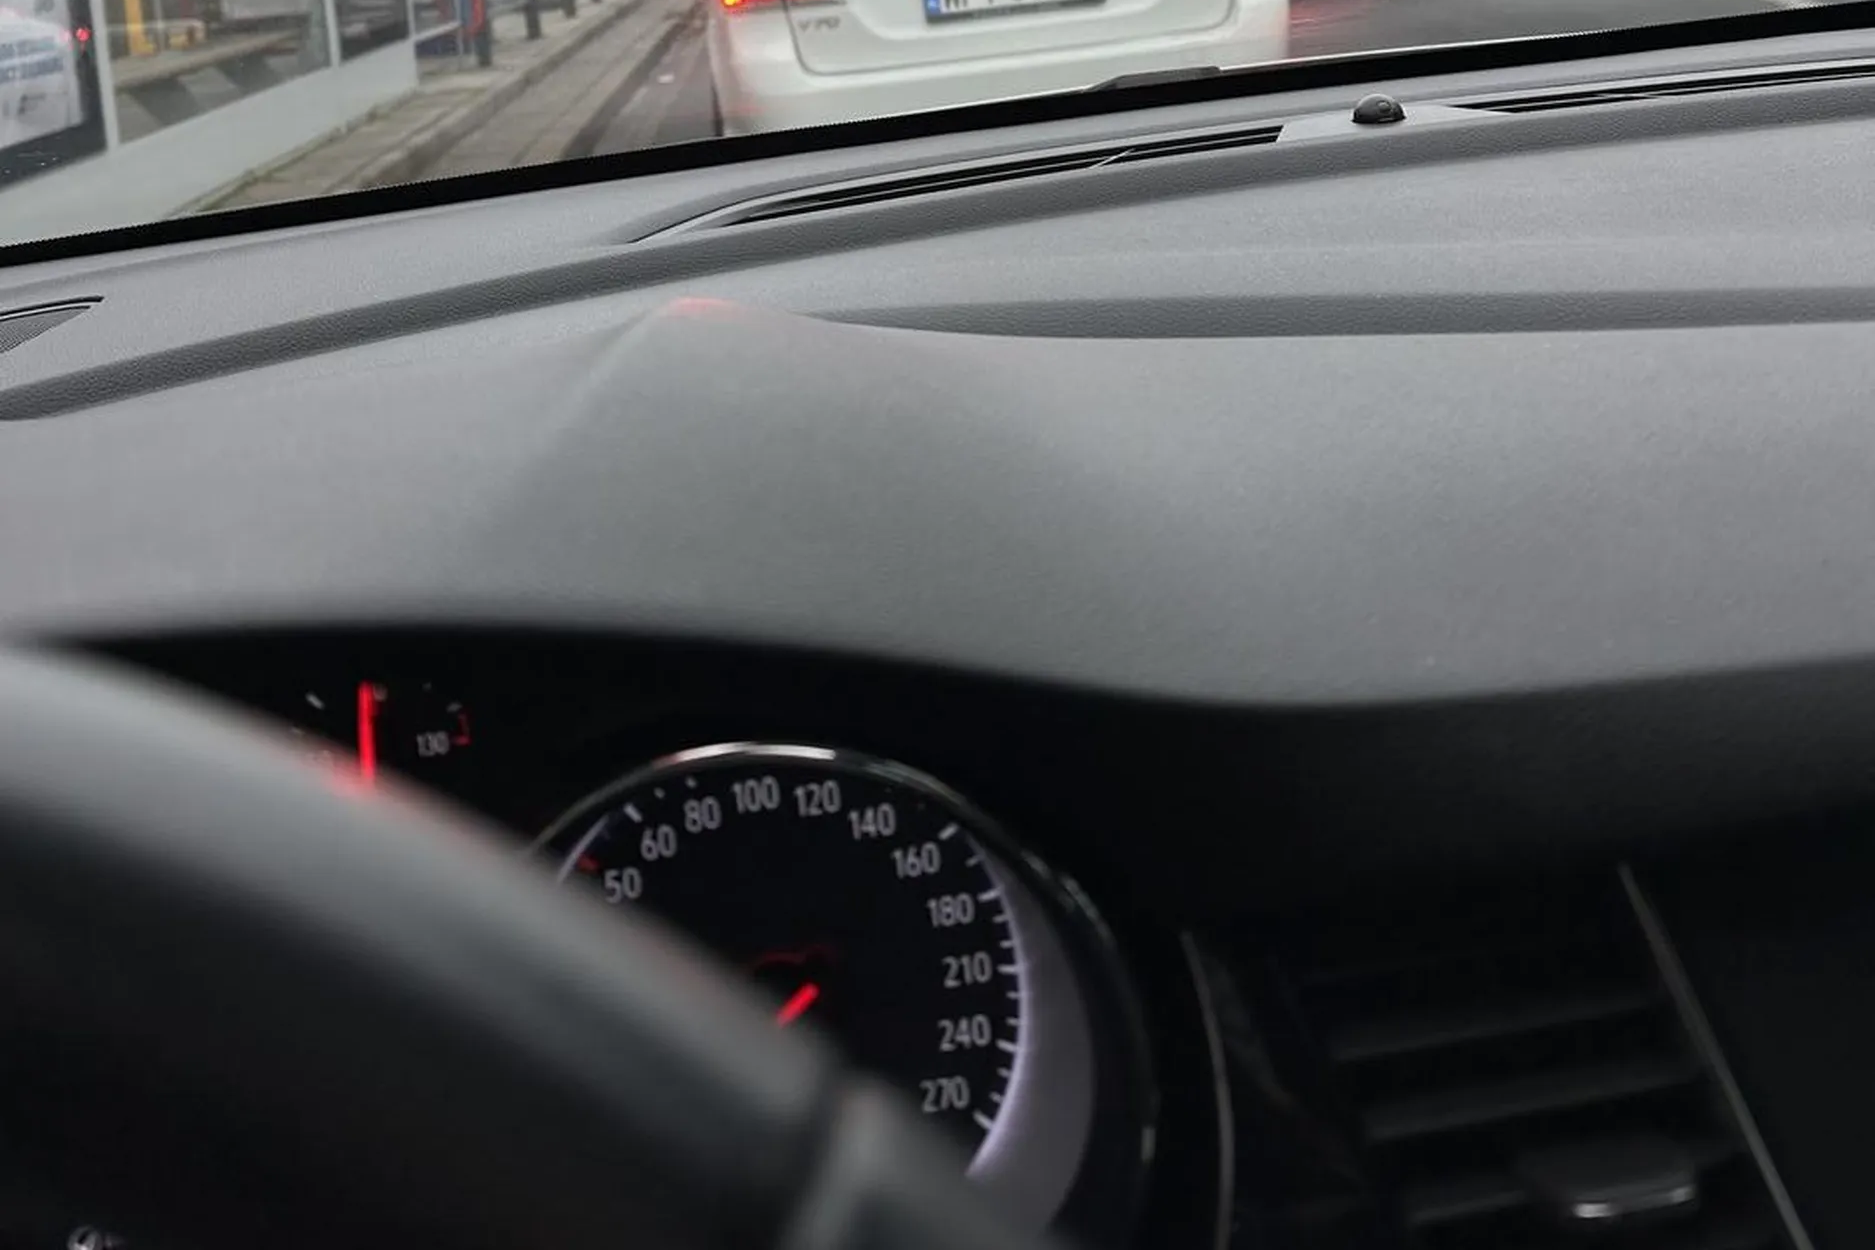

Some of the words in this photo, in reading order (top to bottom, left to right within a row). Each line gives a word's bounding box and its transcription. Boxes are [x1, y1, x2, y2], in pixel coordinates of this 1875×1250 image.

[732, 775, 781, 814] 100
[793, 779, 842, 817] 120
[683, 795, 722, 833] 80
[848, 802, 897, 840] 140
[640, 824, 677, 861] 60
[891, 841, 941, 879] 160
[604, 866, 643, 903] 50
[926, 892, 975, 928] 180
[942, 950, 993, 989] 210
[938, 1013, 992, 1052] 240
[919, 1075, 971, 1114] 270
